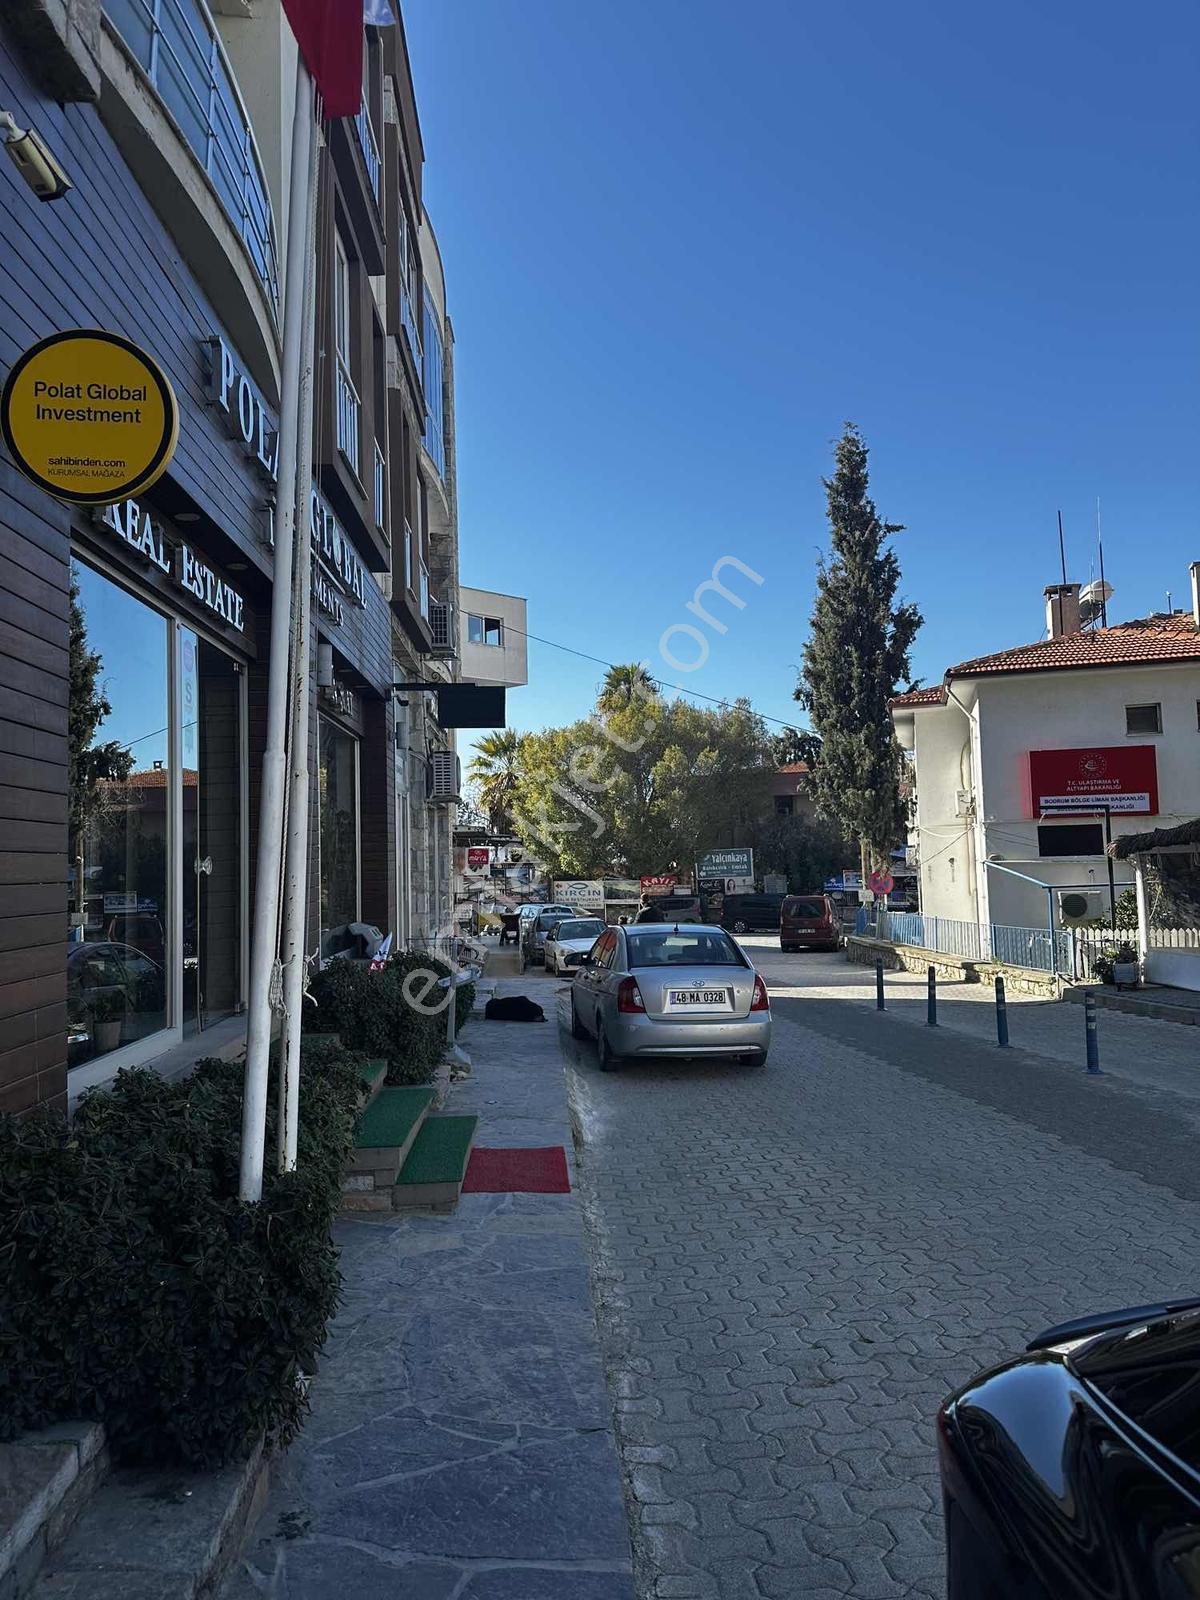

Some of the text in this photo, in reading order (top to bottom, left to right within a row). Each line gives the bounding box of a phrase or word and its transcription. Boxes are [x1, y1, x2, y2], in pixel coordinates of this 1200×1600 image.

[34, 381, 147, 401] Polat Global
[36, 403, 142, 423] Investment
[219, 336, 280, 482] POL
[48, 456, 126, 468] sahibinden.com
[48, 468, 90, 478] KURUMSAL
[102, 498, 244, 632] REAL ESTATE
[676, 992, 687, 1003] 48
[703, 992, 724, 1002] 0328
